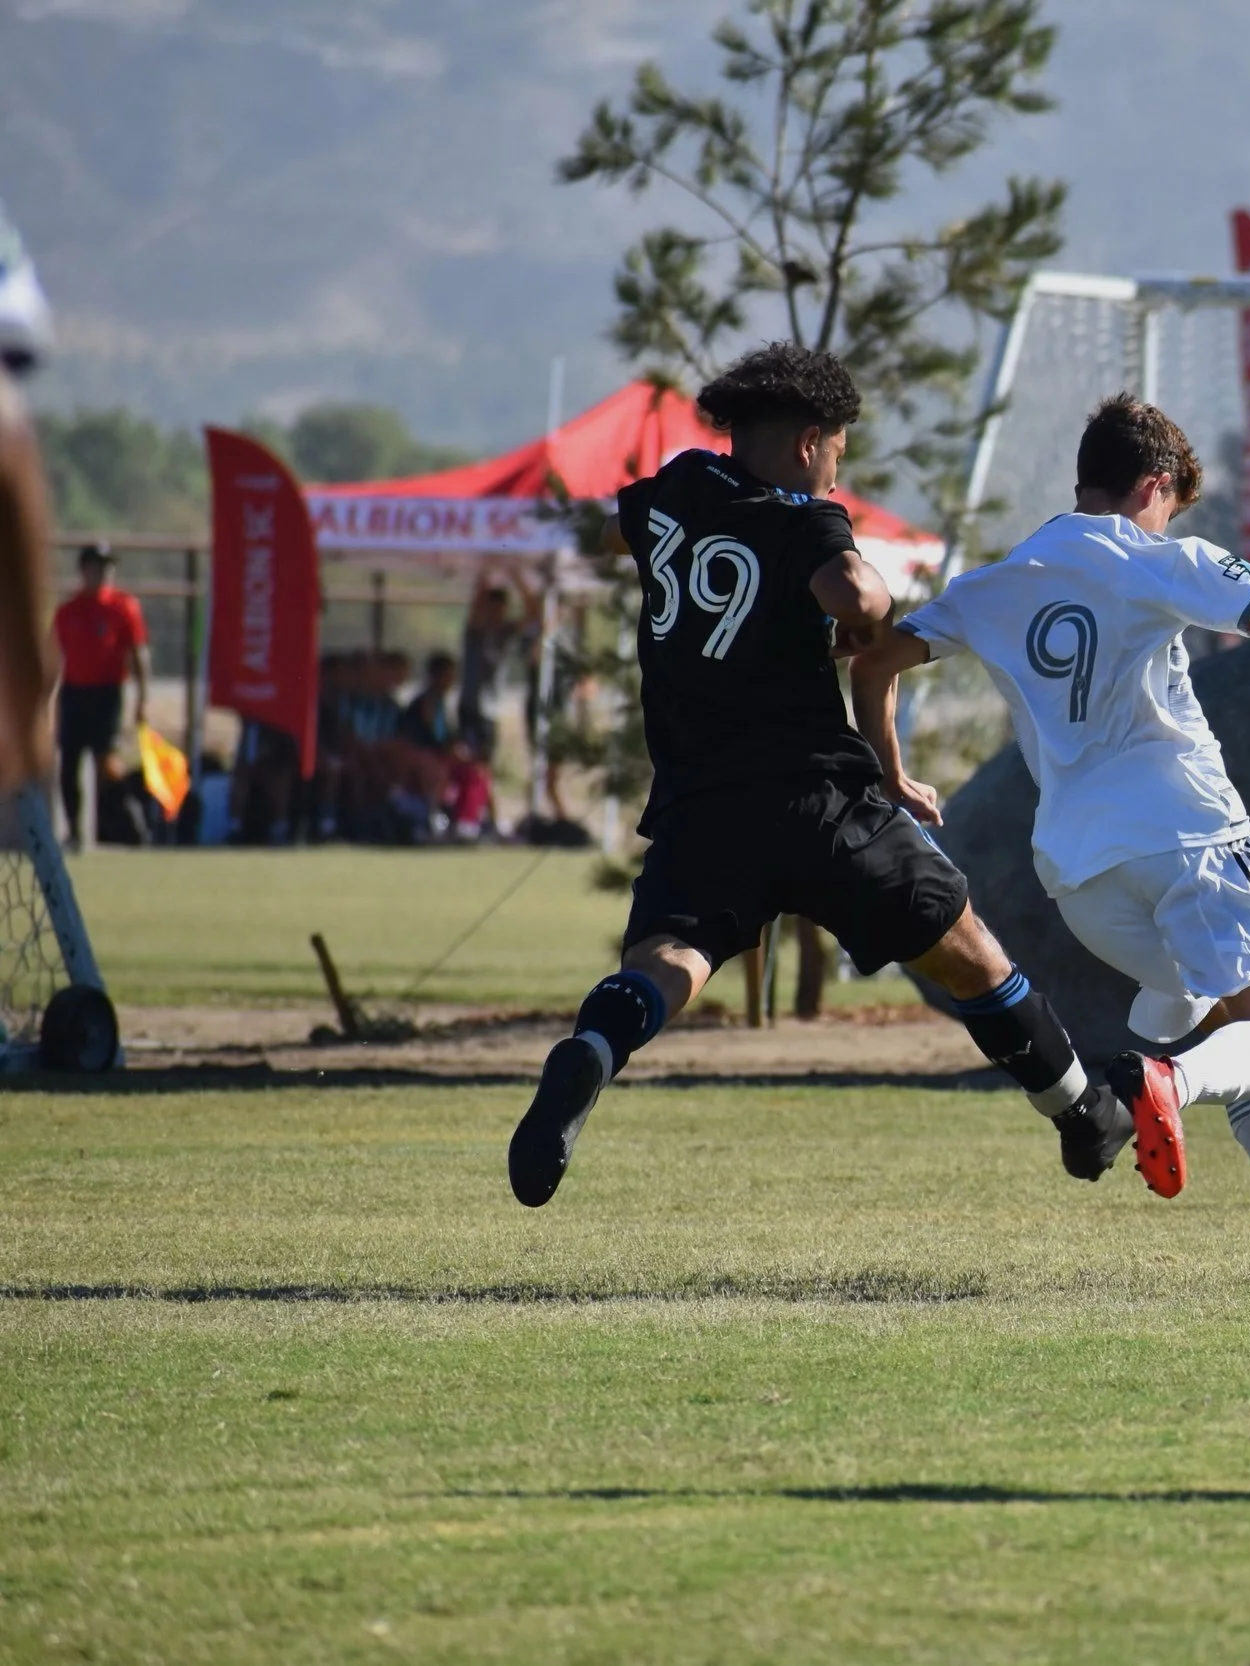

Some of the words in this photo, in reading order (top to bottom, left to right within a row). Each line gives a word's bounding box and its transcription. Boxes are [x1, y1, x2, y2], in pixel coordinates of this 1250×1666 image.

[243, 500, 275, 542] SC
[312, 502, 475, 538] ALBION
[241, 548, 274, 674] ALBION
[648, 507, 760, 660] 39
[1026, 600, 1099, 723] 9
